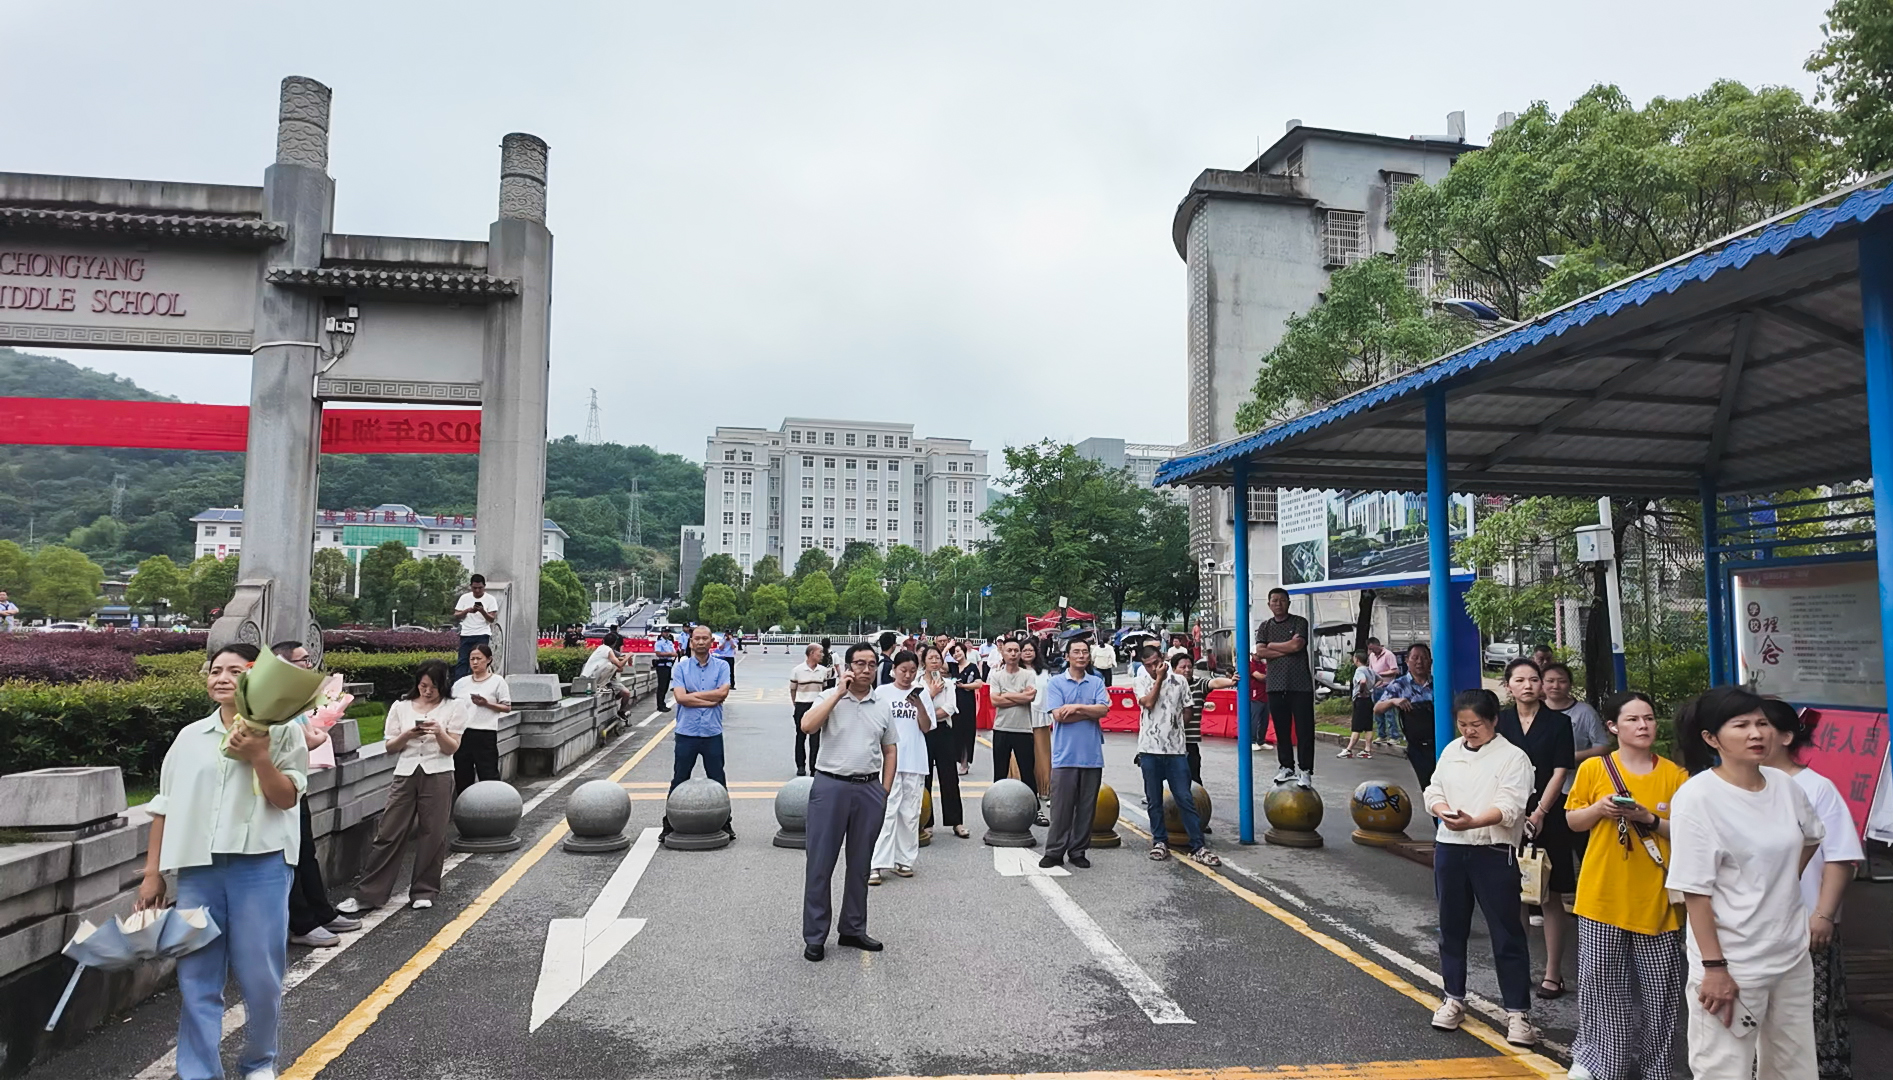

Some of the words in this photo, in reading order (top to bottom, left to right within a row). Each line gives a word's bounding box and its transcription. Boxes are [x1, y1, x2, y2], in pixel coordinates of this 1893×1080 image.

[0, 252, 146, 282] CHONGYANG
[91, 289, 187, 317] SCHOOL
[1802, 722, 1881, 757] 作人员
